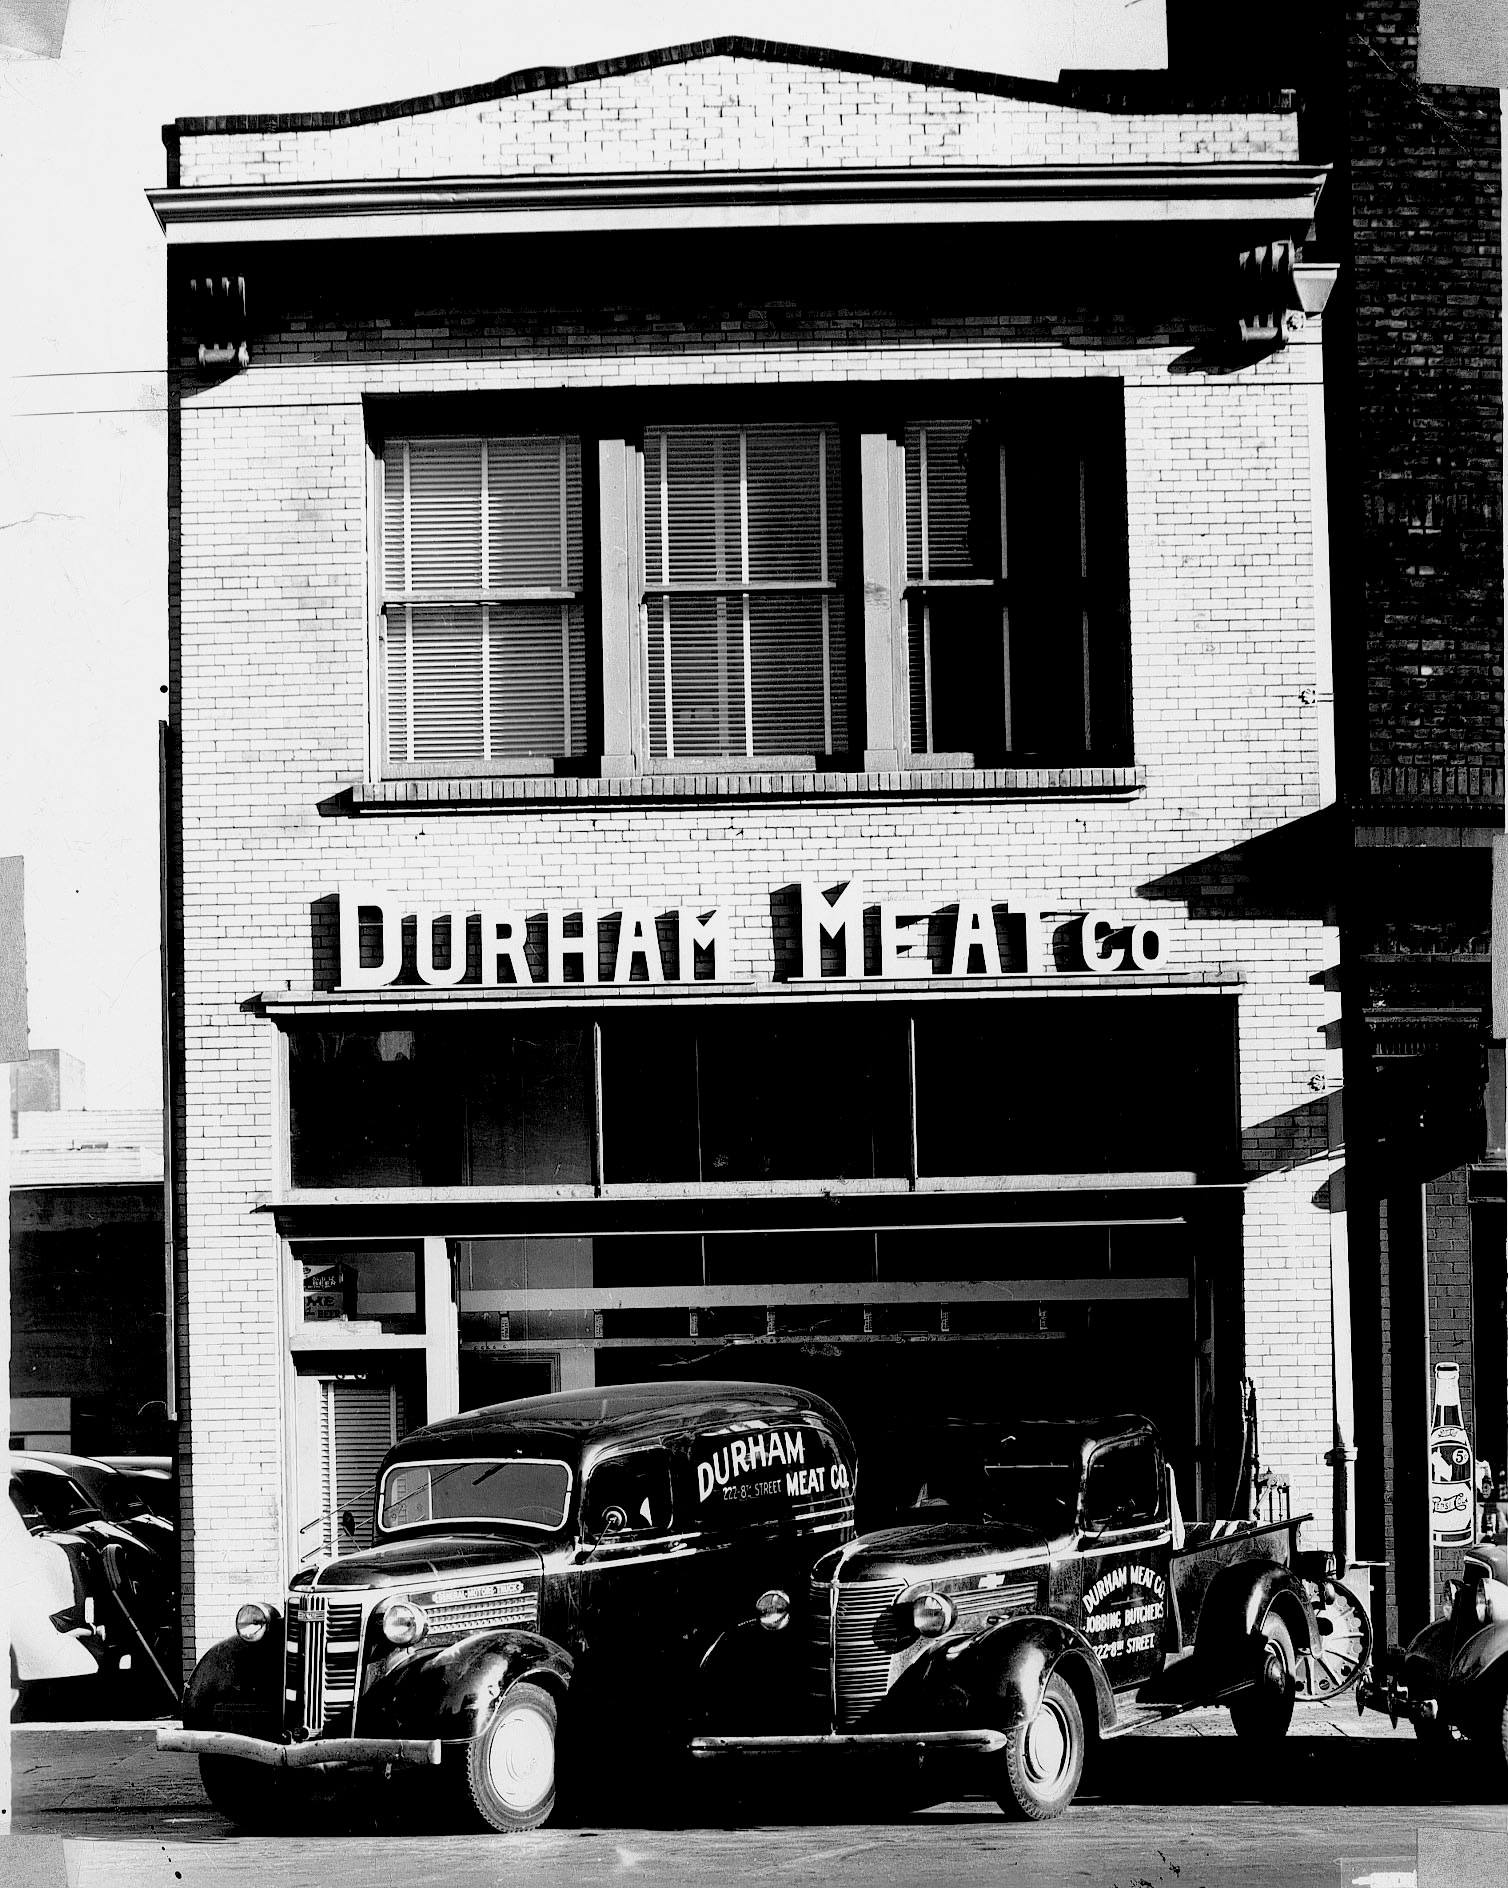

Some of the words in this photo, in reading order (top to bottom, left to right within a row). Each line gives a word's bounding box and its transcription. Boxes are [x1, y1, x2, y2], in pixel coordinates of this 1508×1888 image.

[340, 888, 730, 987] DURHAM
[800, 876, 1057, 978] MEAT
[697, 1431, 805, 1503] DURHAM
[786, 1466, 826, 1497] MEAT
[754, 1479, 782, 1497] STREET
[1082, 1566, 1128, 1614] DURHAM
[1130, 1565, 1156, 1588] MEAT
[1083, 1611, 1121, 1634] JOBBING
[1124, 1601, 1164, 1626] BUTCHERS
[1126, 1632, 1156, 1654] STREET
